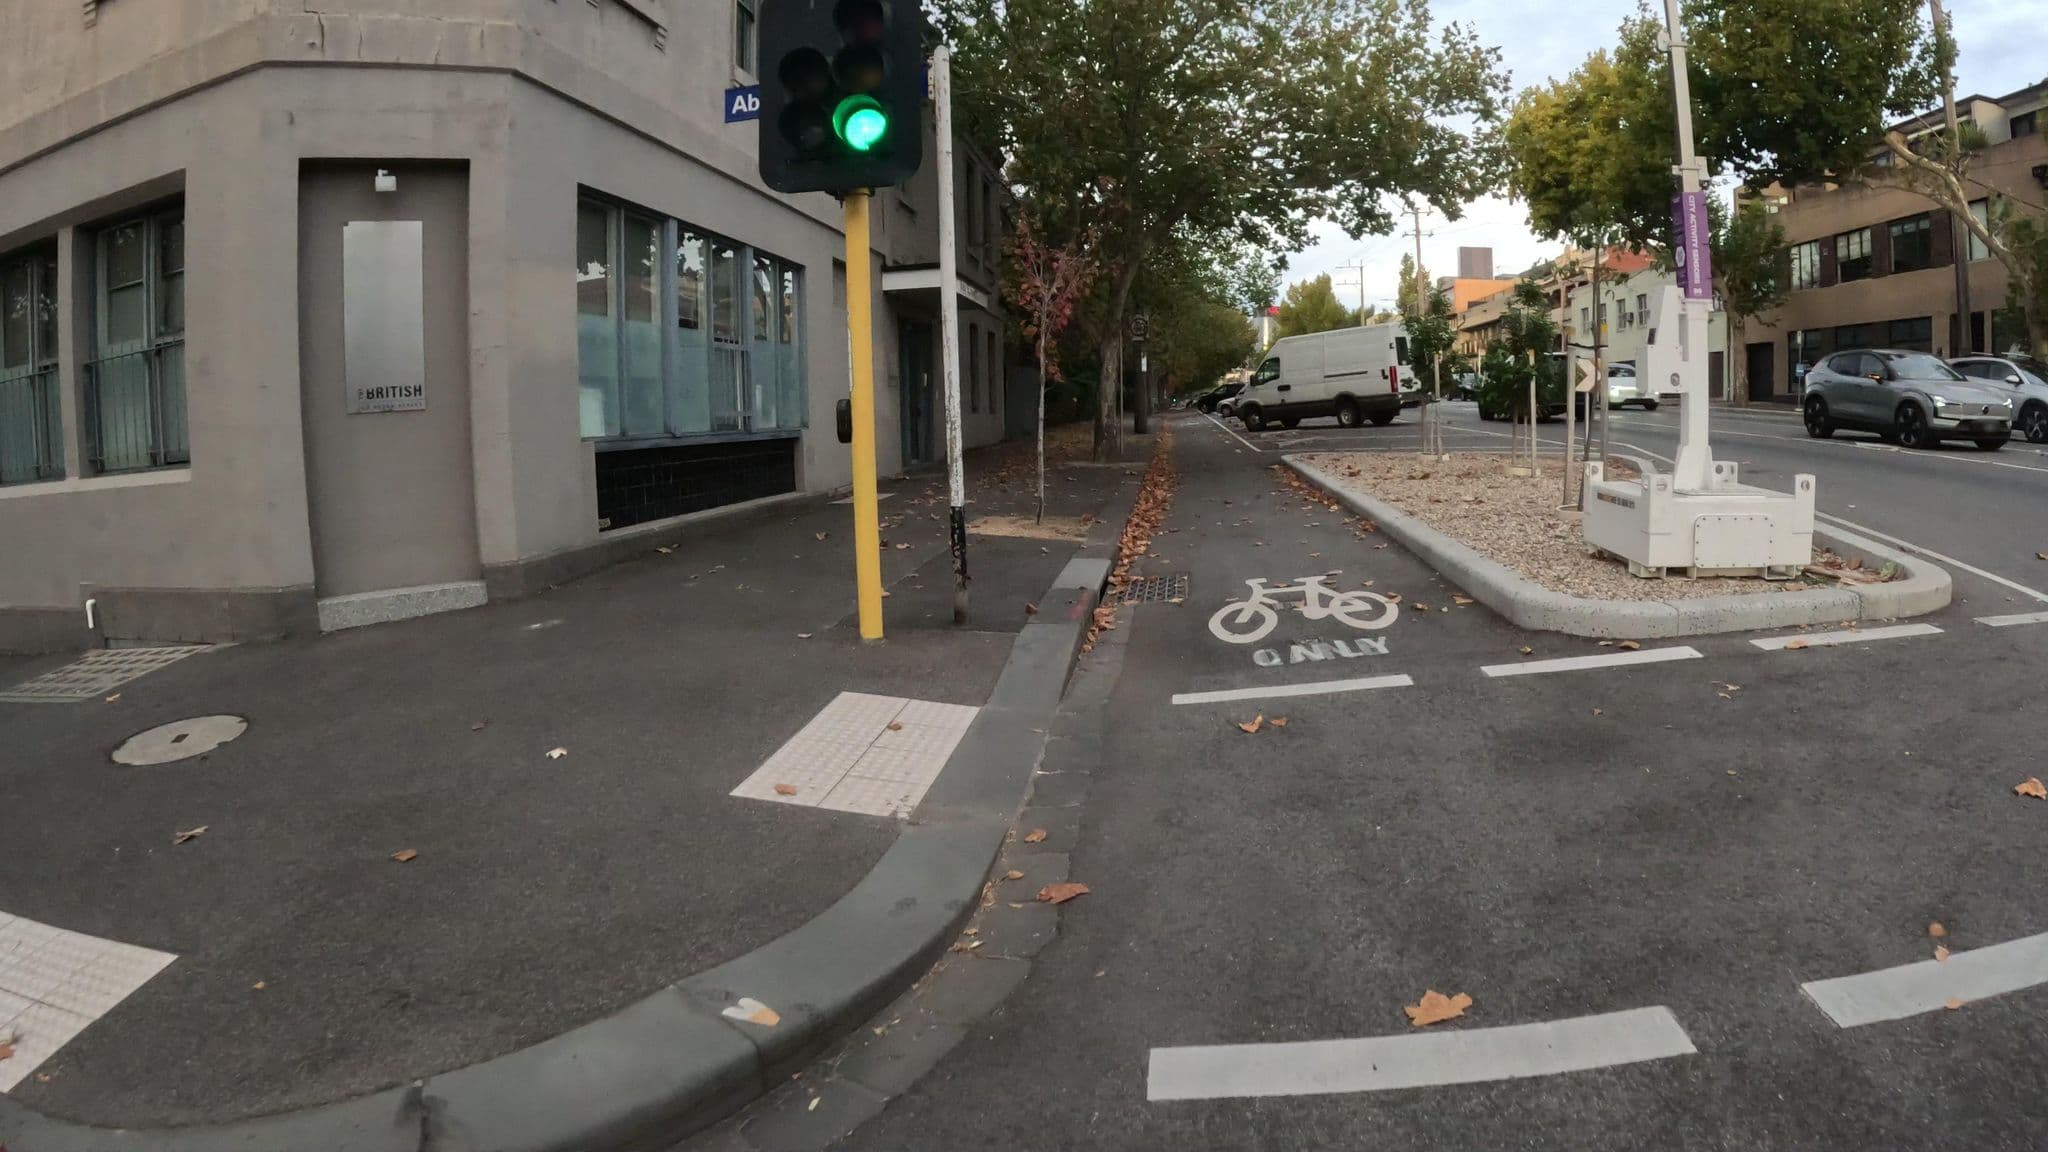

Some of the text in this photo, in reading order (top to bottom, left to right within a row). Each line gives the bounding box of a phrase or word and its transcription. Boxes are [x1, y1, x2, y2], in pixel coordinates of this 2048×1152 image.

[1688, 195, 1696, 213] CITY
[1690, 213, 1698, 248] ACTIVITY
[366, 384, 422, 400] BRITISH
